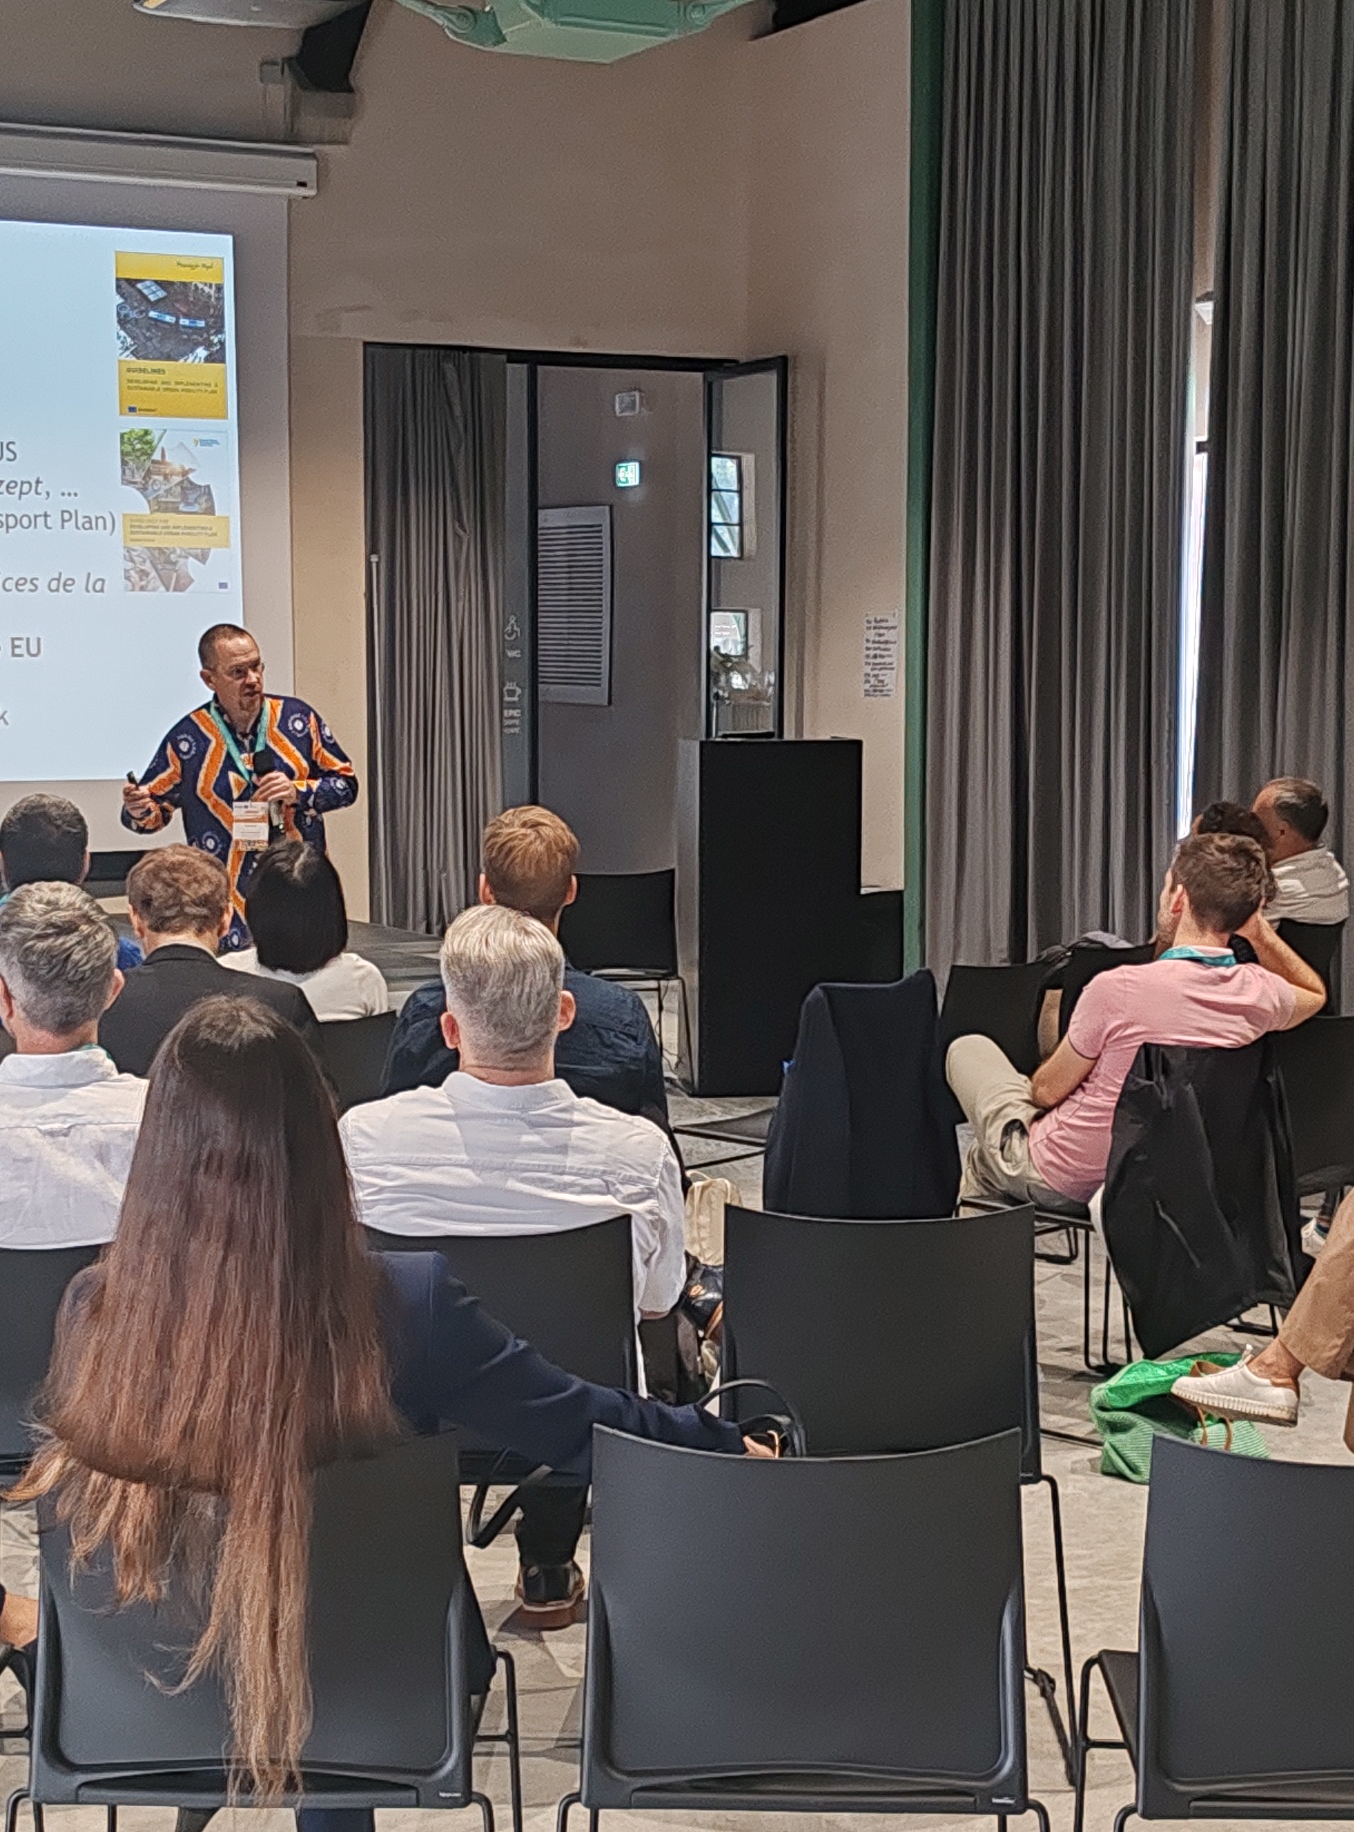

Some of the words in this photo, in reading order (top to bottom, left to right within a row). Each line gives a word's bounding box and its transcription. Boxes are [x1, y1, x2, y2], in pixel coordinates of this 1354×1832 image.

[60, 509, 116, 537] Plan)
[47, 571, 76, 594] de
[84, 571, 106, 594] la
[10, 636, 42, 658] EU
